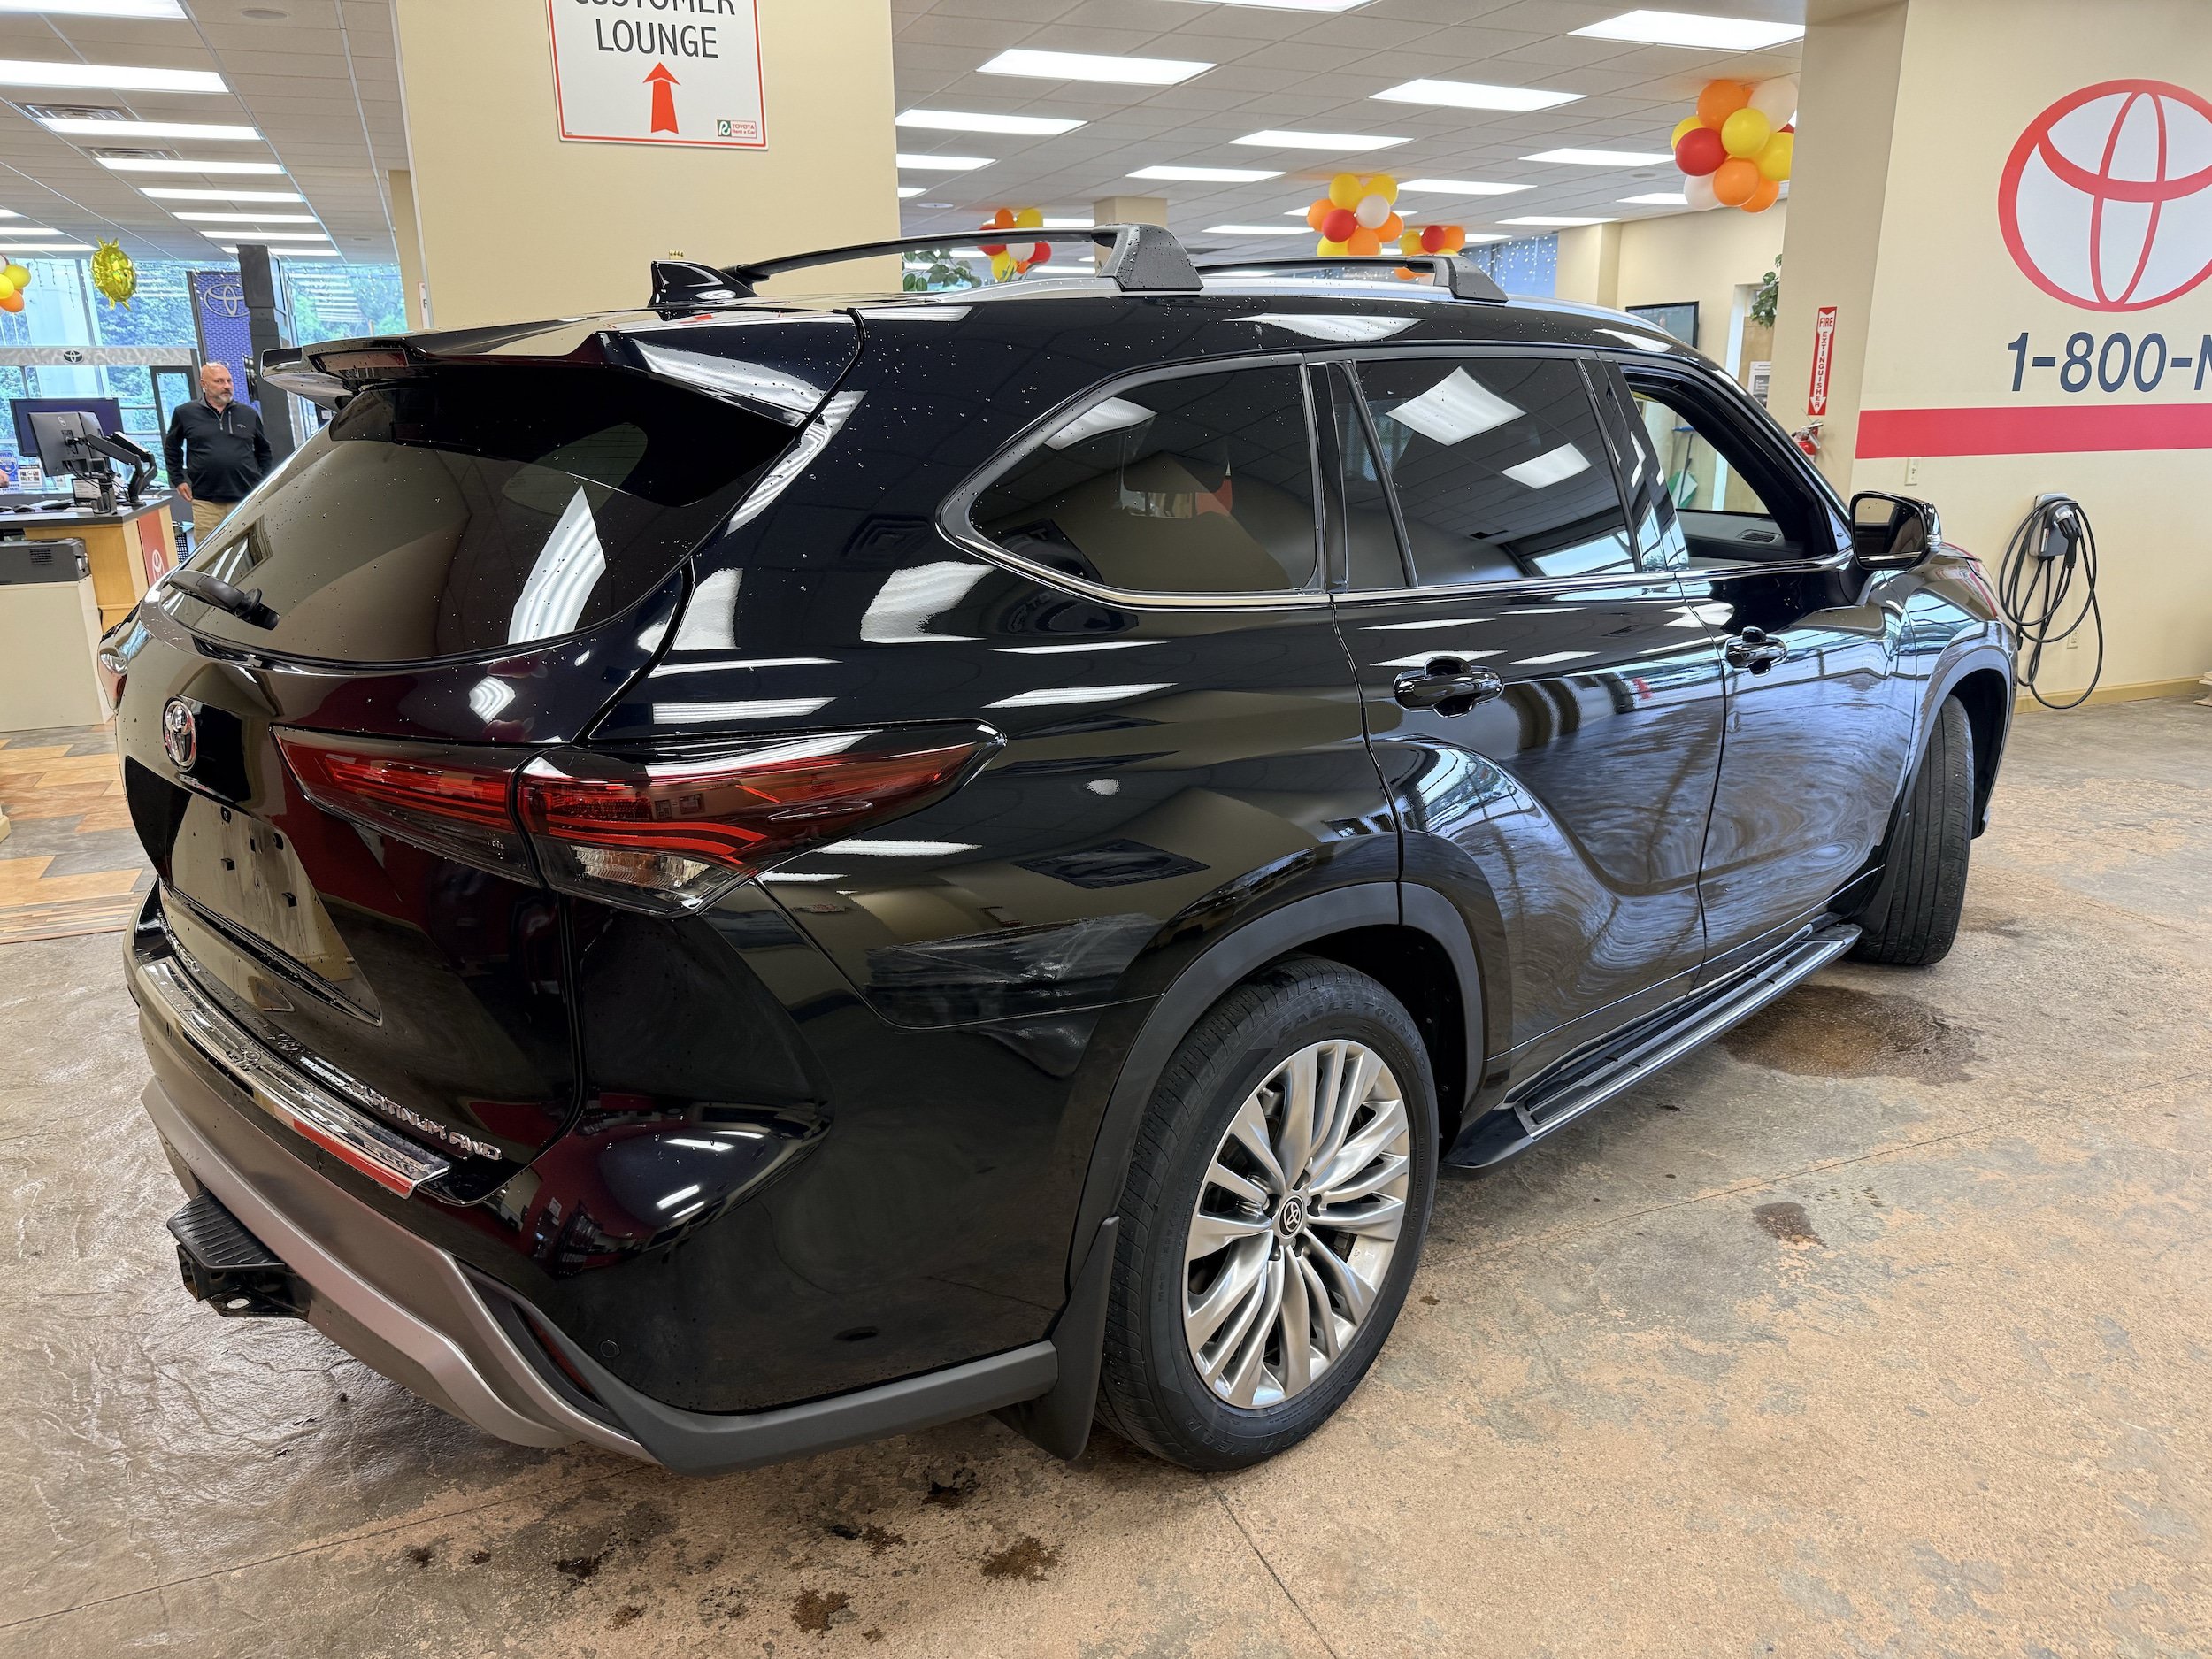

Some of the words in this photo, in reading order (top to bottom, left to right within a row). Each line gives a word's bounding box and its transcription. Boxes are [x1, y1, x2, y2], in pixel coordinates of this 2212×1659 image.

[595, 19, 718, 58] LOUNGE
[1819, 317, 1833, 327] FIRE
[1814, 331, 1828, 408] EXTINGUISHER
[352, 1081, 448, 1140] PLATINUM
[449, 1131, 503, 1160] AWD
